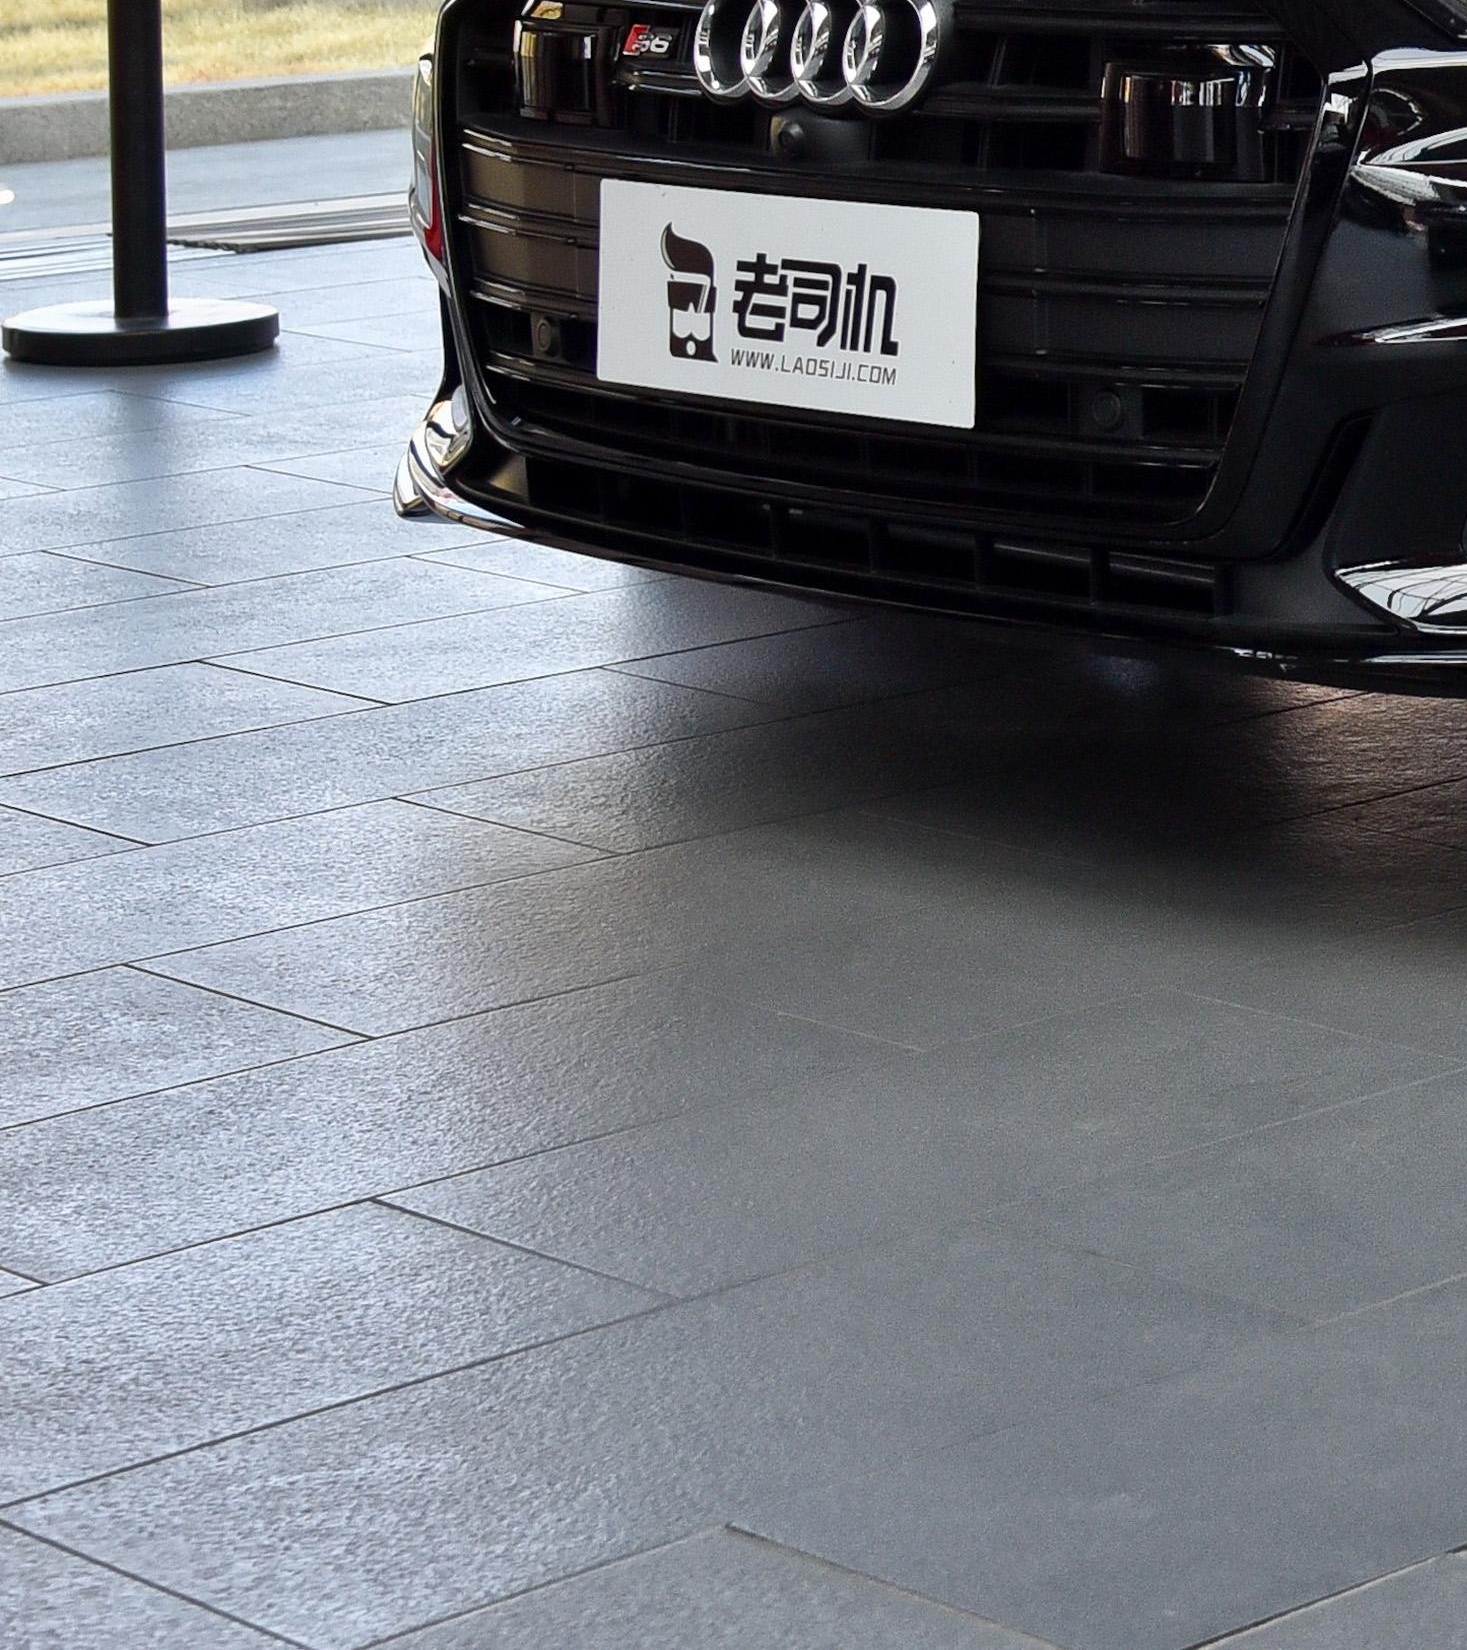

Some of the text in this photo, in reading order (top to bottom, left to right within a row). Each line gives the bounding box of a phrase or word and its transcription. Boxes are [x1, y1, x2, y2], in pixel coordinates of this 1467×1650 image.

[630, 31, 673, 54] S6
[732, 252, 899, 356] 老司机
[731, 348, 897, 385] WWW.LAOSIJI.COM
